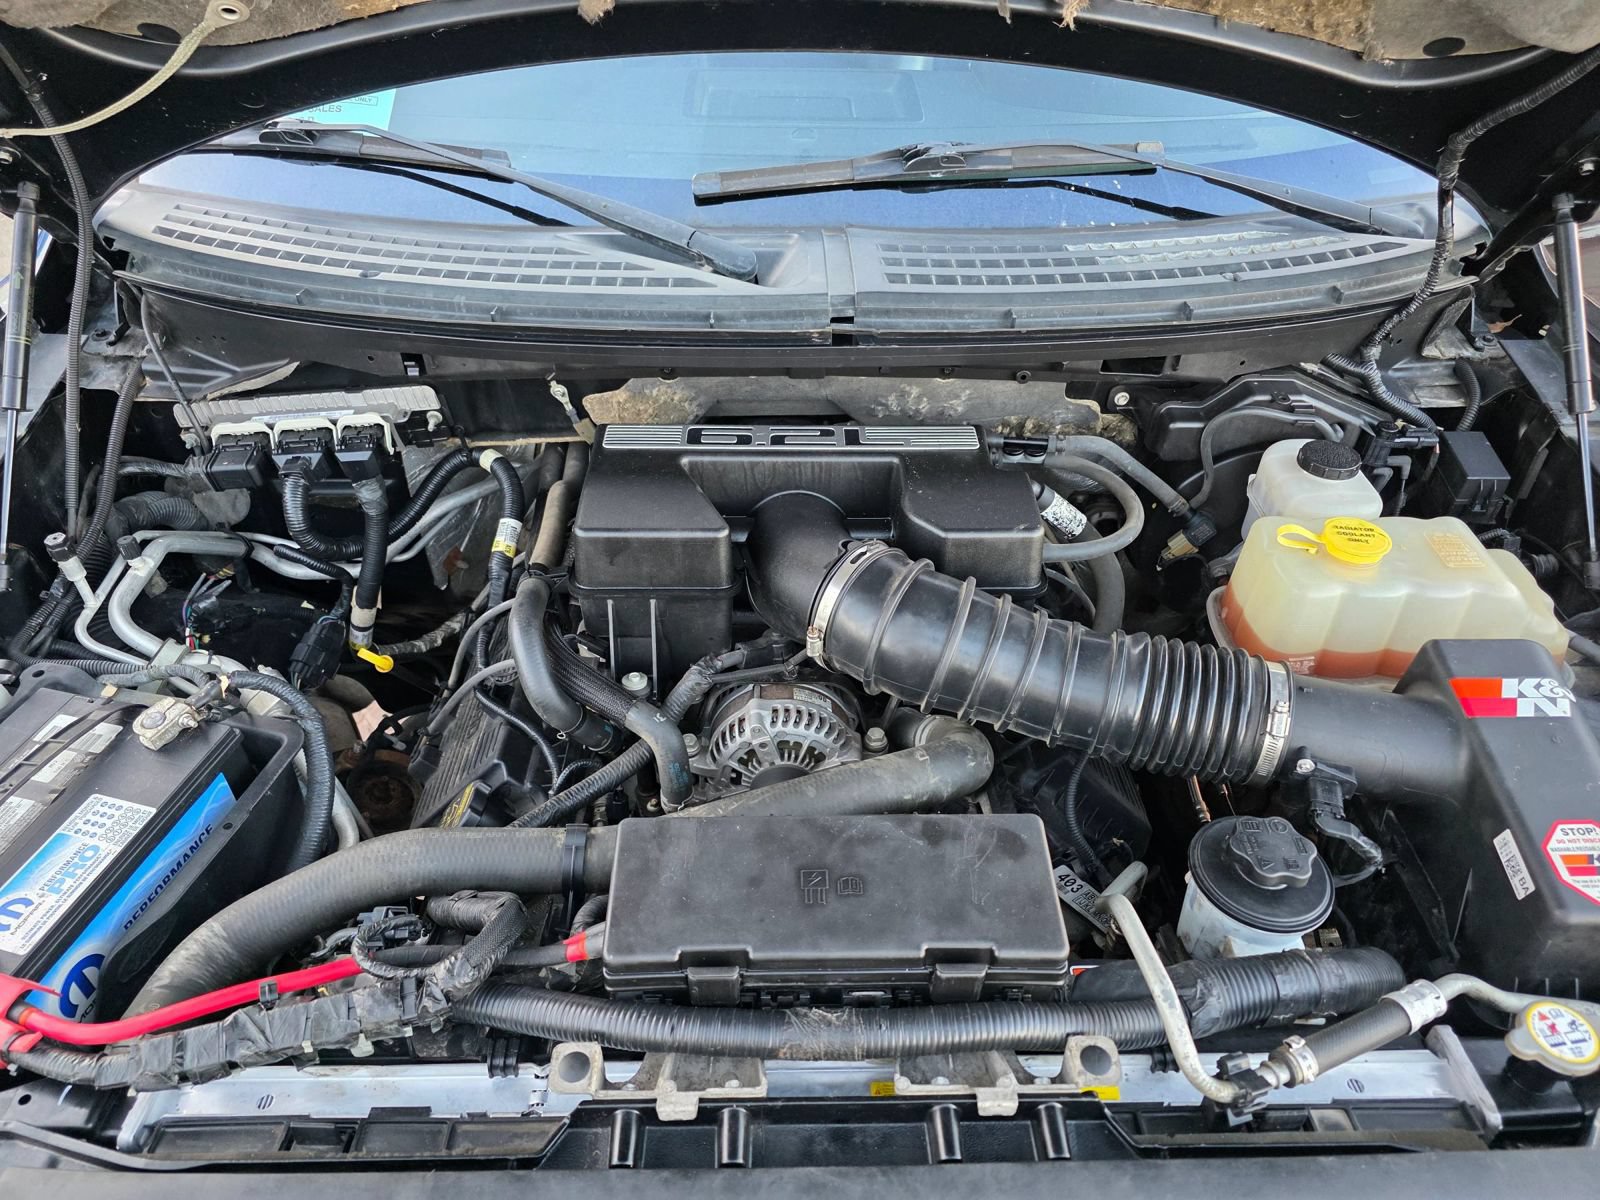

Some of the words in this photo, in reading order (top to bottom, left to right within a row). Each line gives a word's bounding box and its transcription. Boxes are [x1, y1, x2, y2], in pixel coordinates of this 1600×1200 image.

[1501, 678, 1577, 717] K&N
[1560, 827, 1598, 836] STOP!
[38, 840, 90, 892] PERFORMANCE
[45, 842, 103, 897] PRO
[1058, 874, 1084, 893] 403
[9, 901, 43, 936] MOPAR
